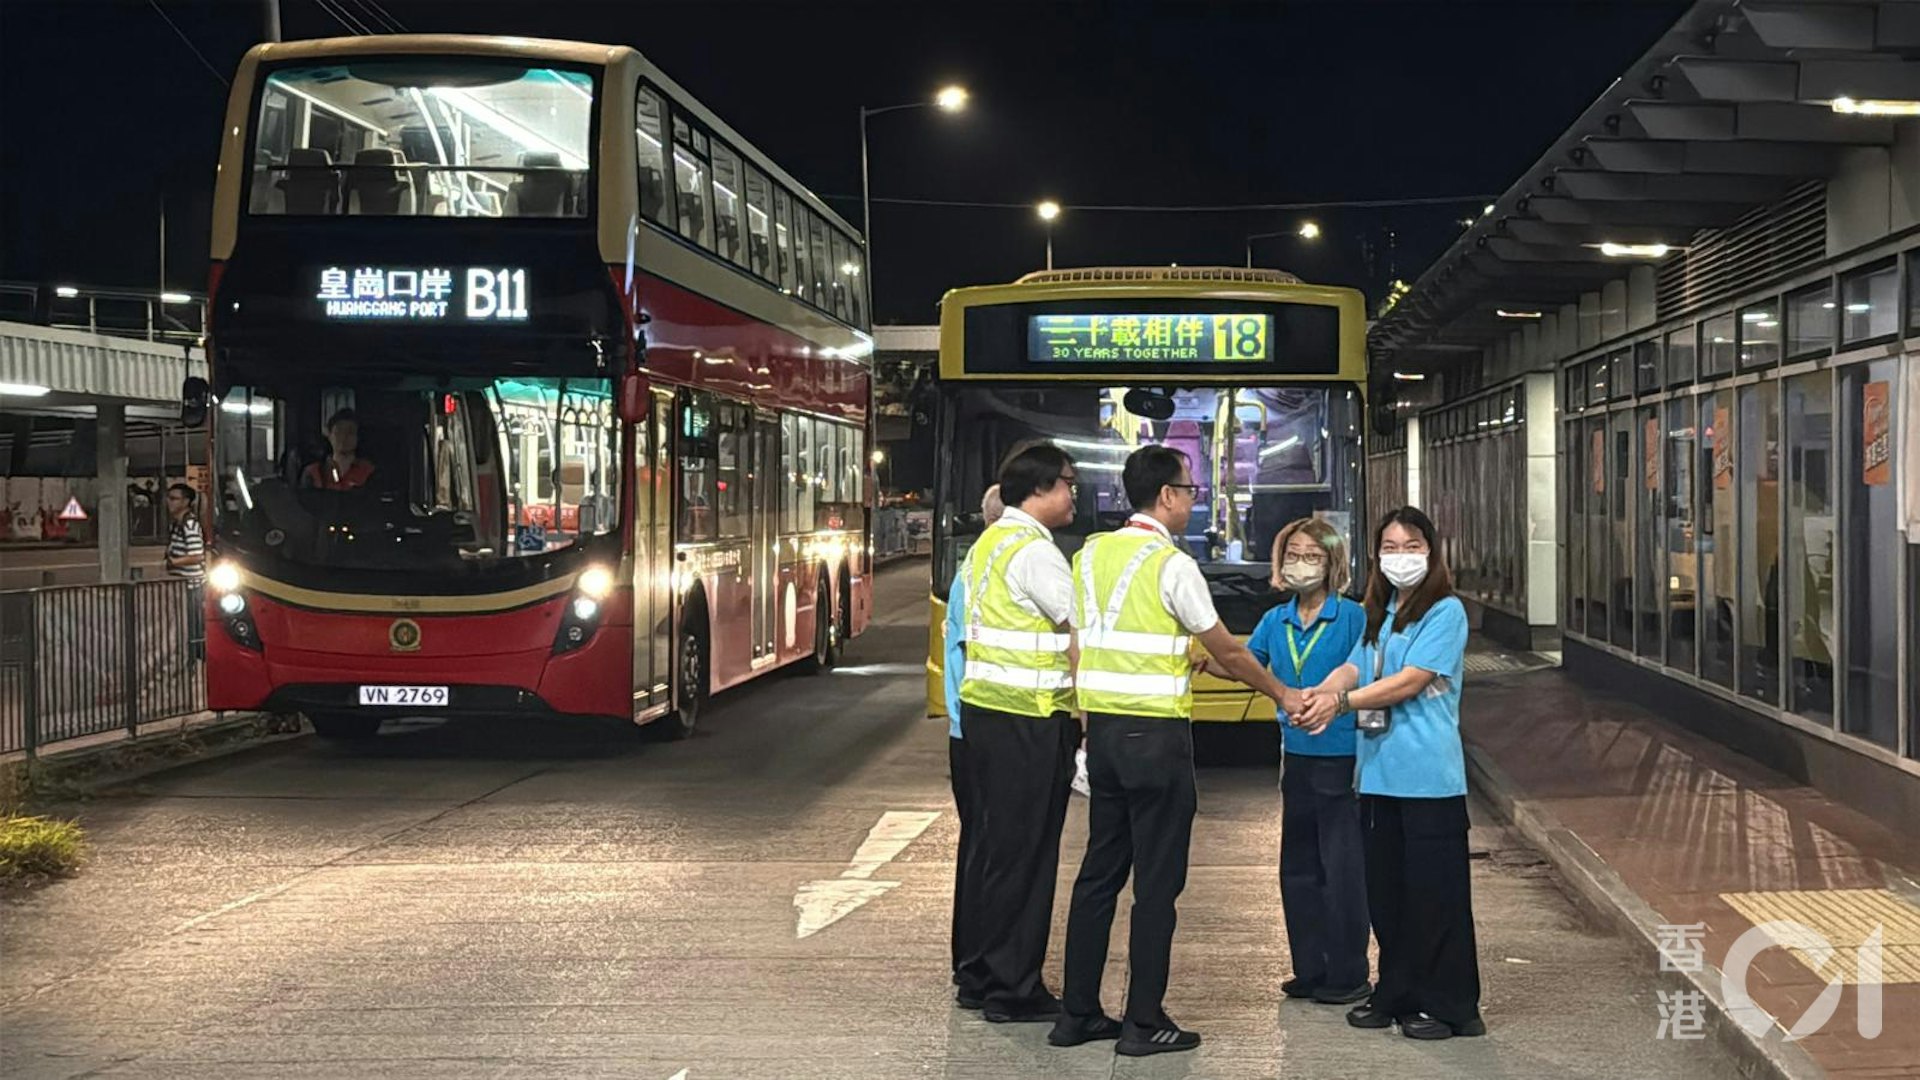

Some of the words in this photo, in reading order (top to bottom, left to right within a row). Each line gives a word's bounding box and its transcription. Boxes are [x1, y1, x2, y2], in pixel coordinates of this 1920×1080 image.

[317, 267, 451, 299] 皇崗口岸
[467, 268, 528, 317] B11
[326, 301, 406, 316] HUANGGANG
[410, 301, 448, 316] PORT
[1040, 316, 1203, 346] 三十載相伴
[1217, 317, 1262, 357] 18
[1053, 347, 1069, 358] 30
[1074, 347, 1119, 358] YEARS
[1124, 347, 1198, 358] TOGETHER
[365, 688, 389, 703] VN
[396, 688, 444, 703] 2769
